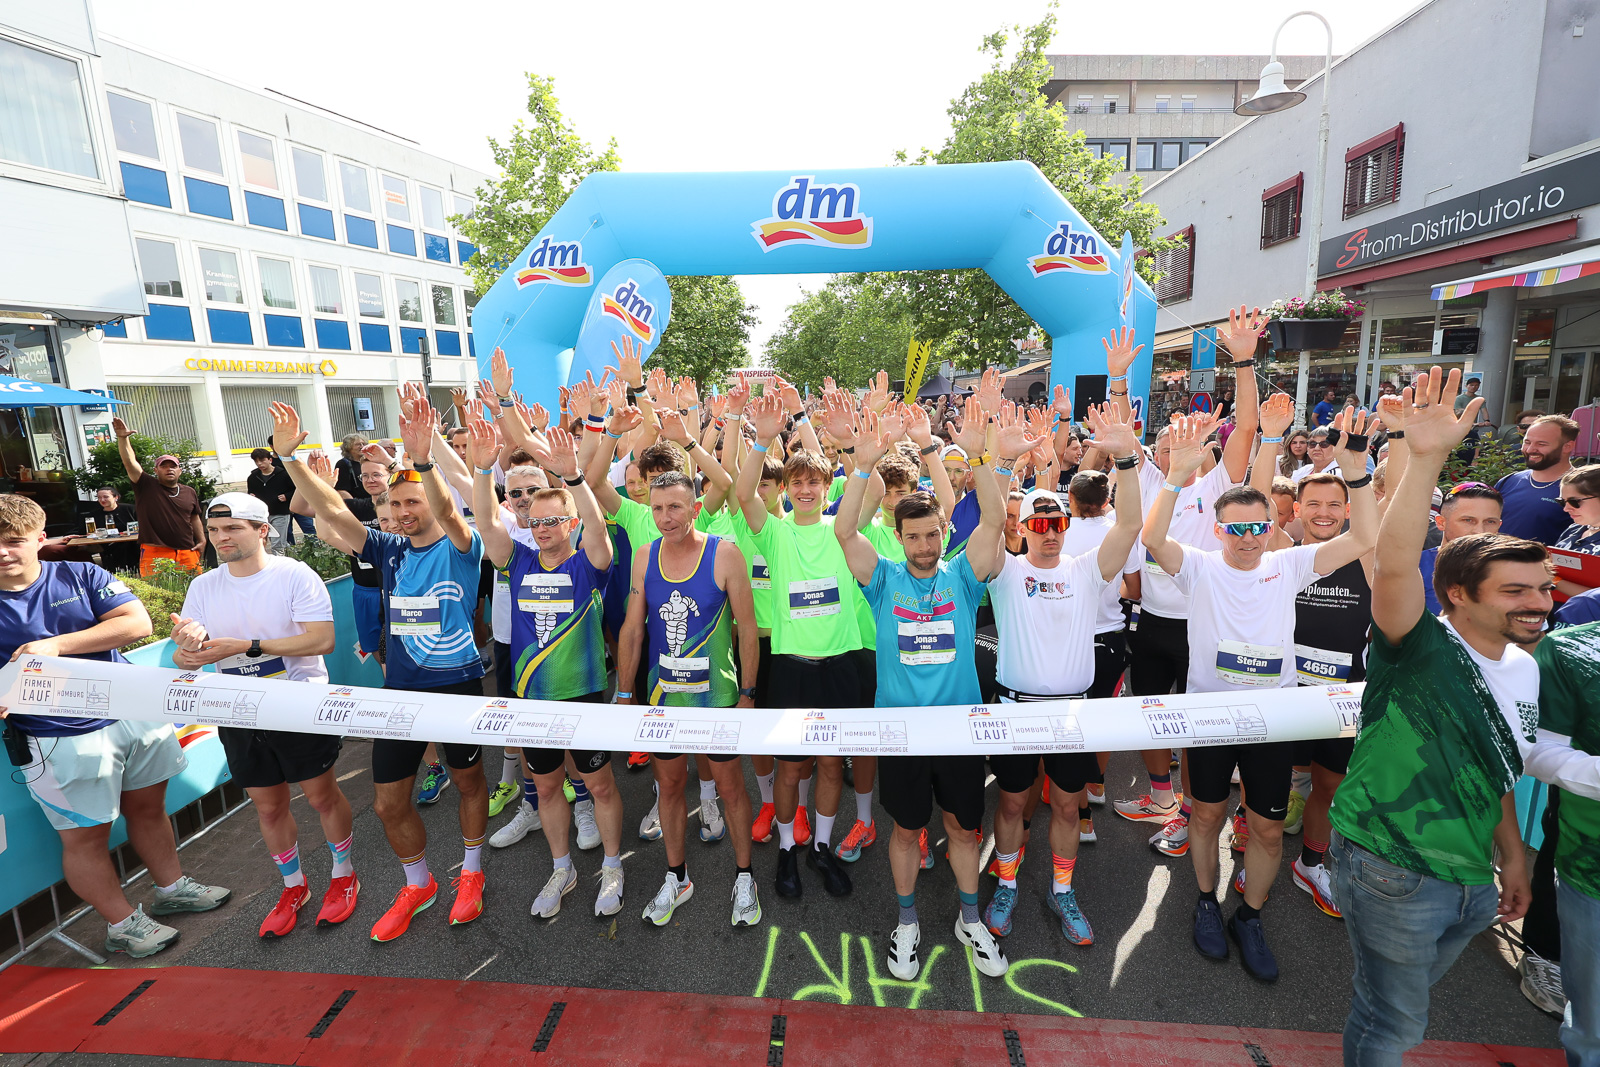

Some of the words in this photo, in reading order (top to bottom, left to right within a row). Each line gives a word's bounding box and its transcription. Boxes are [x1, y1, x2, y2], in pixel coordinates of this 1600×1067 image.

[777, 178, 856, 220] dm
[1335, 185, 1565, 268] Strom-Distributor.io
[1047, 224, 1097, 256] dm
[528, 238, 578, 268] dm
[205, 270, 237, 279] Kranken-
[206, 280, 240, 289] gymnastik
[614, 281, 654, 322] dm
[1196, 333, 1211, 365] P
[185, 358, 317, 374] COMMERZBANK
[726, 370, 774, 378] CHNSPIEGEL
[531, 586, 559, 594] Sascha
[1304, 583, 1350, 597] iplomaten
[802, 591, 825, 600] Jonas
[401, 609, 423, 617] Marco
[914, 635, 938, 644] Jonas
[27, 659, 42, 669] dm
[1236, 655, 1268, 667] Stefan
[239, 665, 261, 675] Théo
[1303, 660, 1337, 676] 4650
[179, 672, 198, 680] dm
[671, 670, 692, 678] Marc
[24, 678, 52, 688] FIRMEN
[168, 688, 200, 698] FIRMEN
[1327, 685, 1347, 693] dm
[22, 689, 51, 702] LAUF
[57, 690, 85, 698] HOMBURG
[167, 699, 196, 712] LAUF
[202, 700, 231, 709] HOMBURG
[323, 699, 355, 708] FIRMEN
[1142, 697, 1161, 705] dm
[1337, 701, 1362, 711] FIRM
[49, 709, 110, 717] WWW.FIRMENLAUF-HOMBURG.DE
[318, 709, 350, 722] LAUF
[356, 710, 388, 718] HOMBURG
[482, 712, 515, 720] FIRMEN
[1148, 712, 1185, 721] FIRMEN
[196, 718, 257, 727] WWW.FIRMENLAUF-HOMBURG.DE
[1194, 718, 1231, 726] HOMBURG
[1344, 713, 1359, 727] LA
[476, 720, 511, 732] LAUF
[1015, 726, 1049, 734] HOMBURG
[1153, 721, 1188, 735] LAUF
[347, 729, 411, 738] WWW.FIRMENLAUF-HOMBURG.DE
[639, 729, 672, 739] LAUF
[805, 732, 837, 742] LAUF
[975, 729, 1008, 740] LAUF
[505, 738, 572, 746] WWW.FIRMENLAUF-HOMBURG.DE
[1192, 736, 1267, 745] WWW.FIRMENLAUF-HOMBURG.DE
